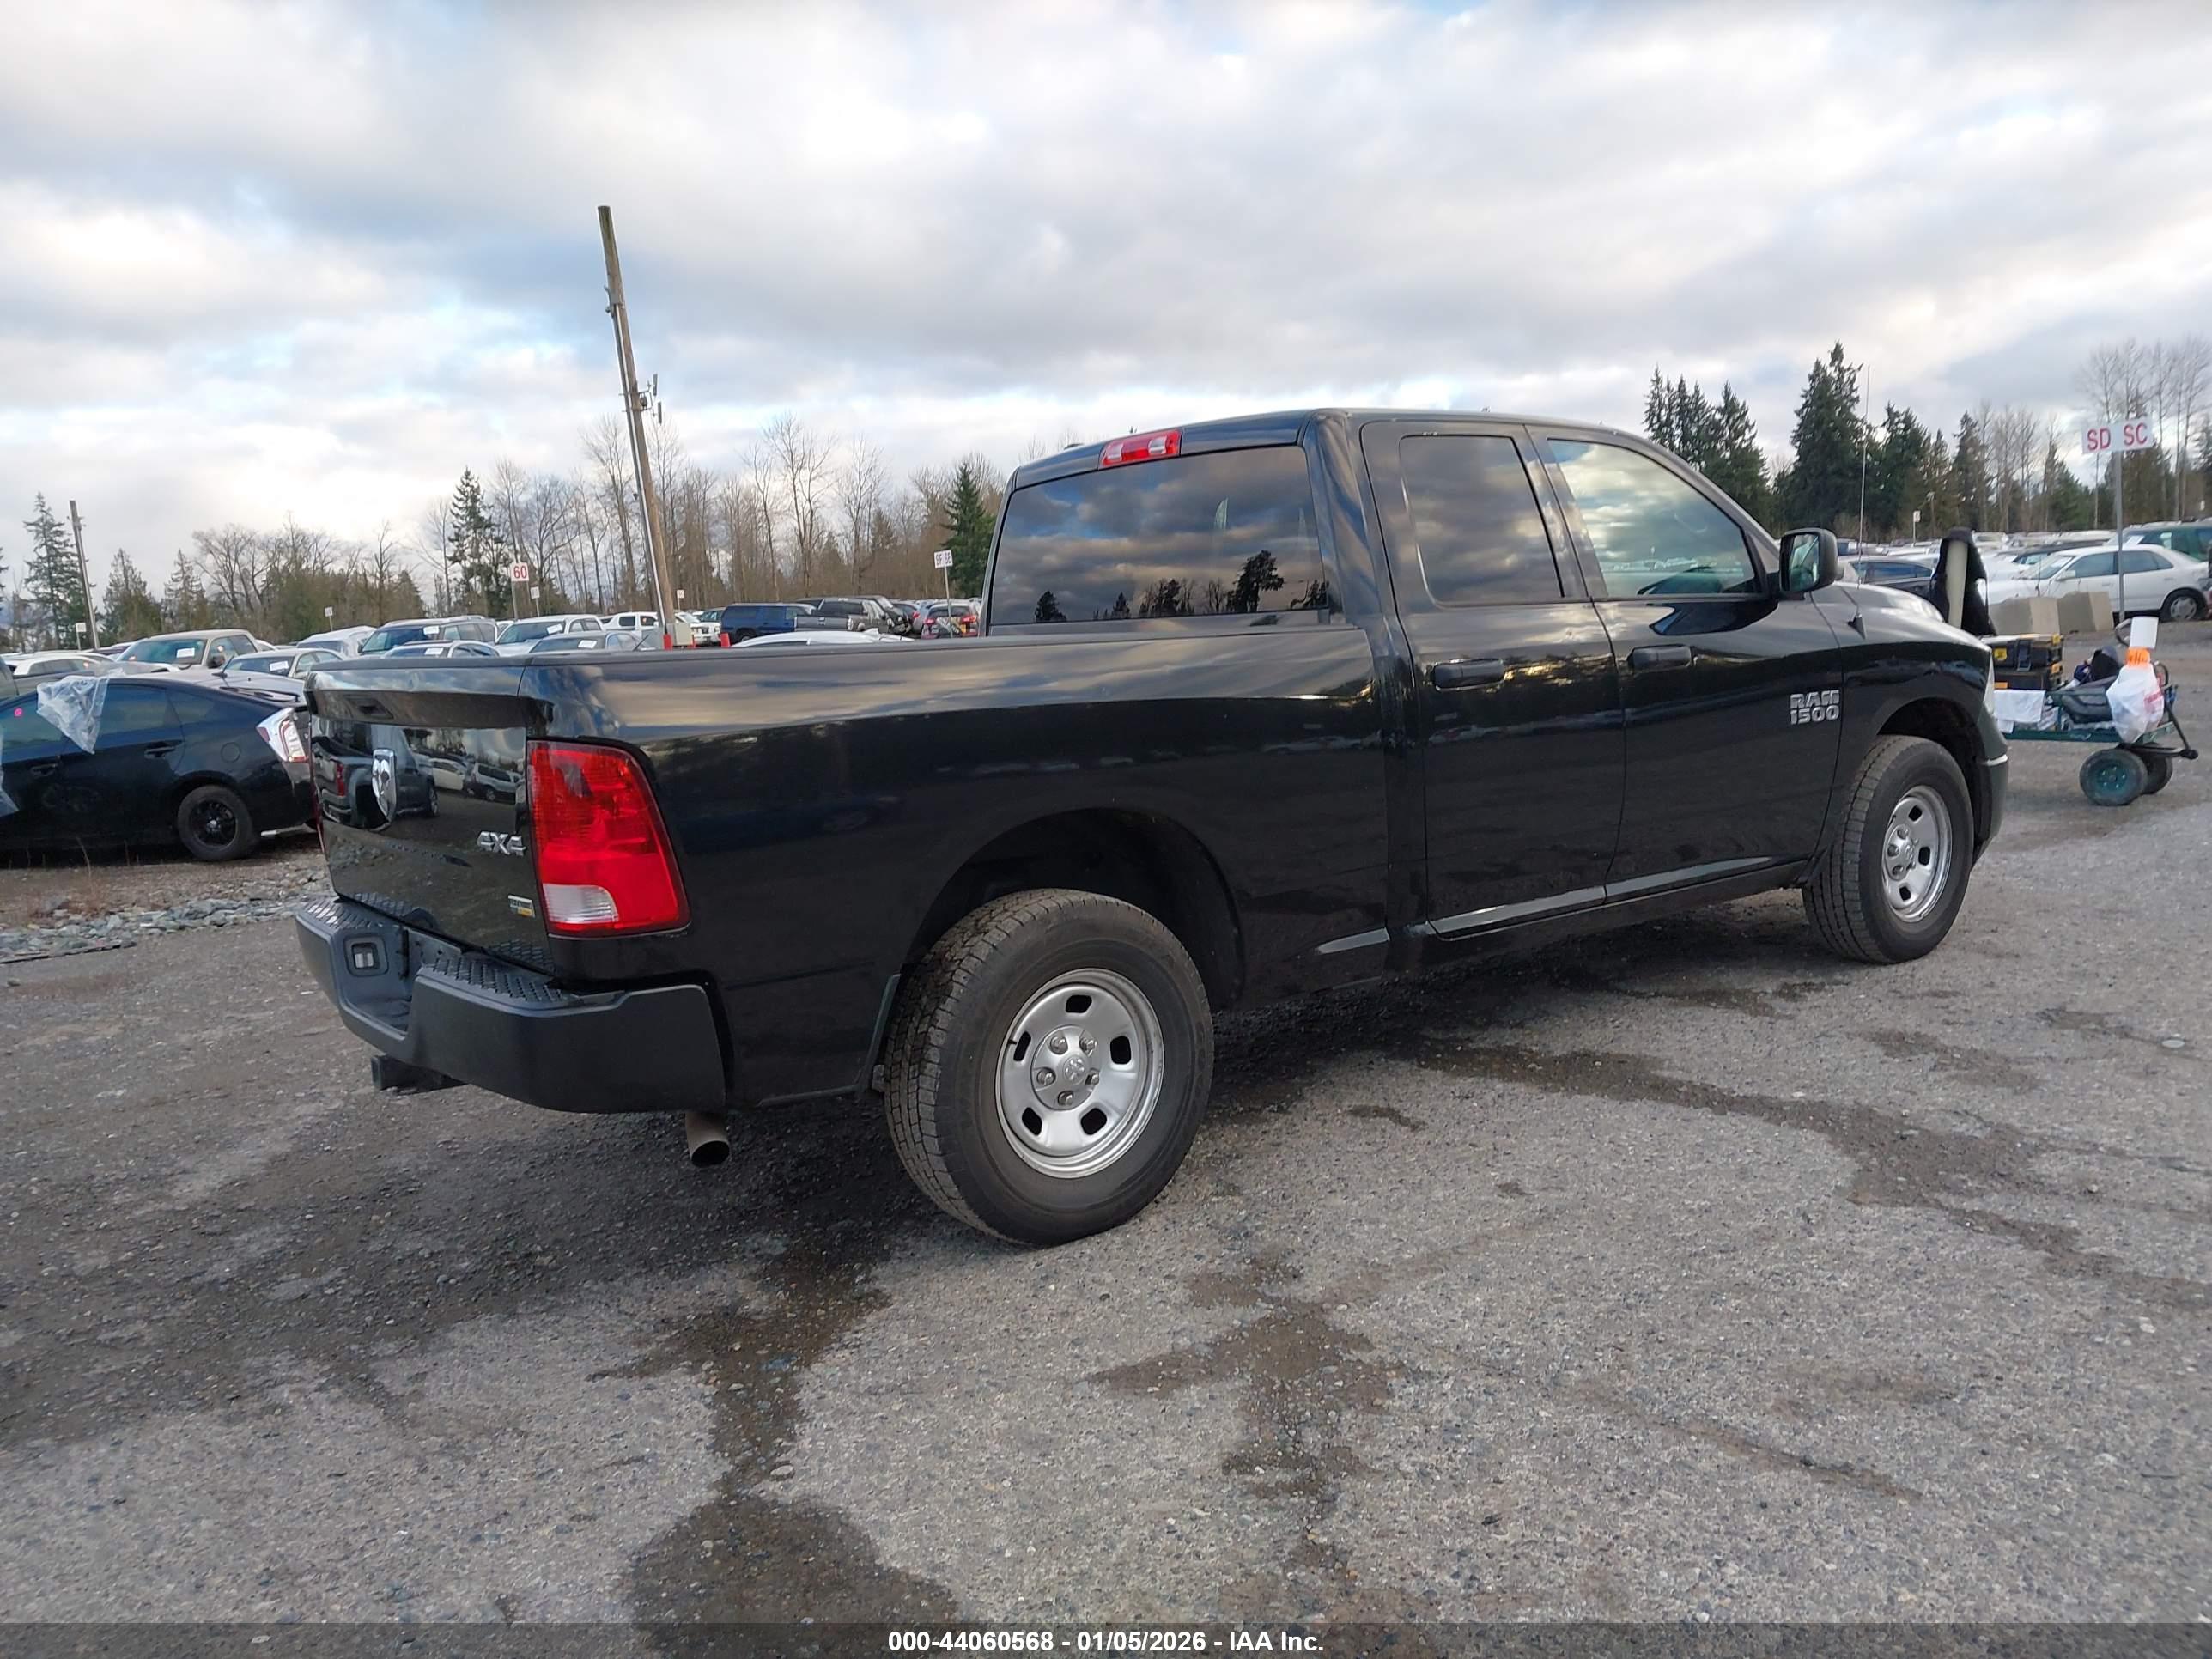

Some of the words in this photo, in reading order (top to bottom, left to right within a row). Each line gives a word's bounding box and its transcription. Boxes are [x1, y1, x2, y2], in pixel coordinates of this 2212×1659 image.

[2087, 427, 2112, 452] SD
[2123, 422, 2148, 447] SC
[514, 564, 527, 580] 60
[1790, 689, 1840, 709] RAM
[1790, 704, 1840, 725] 1500
